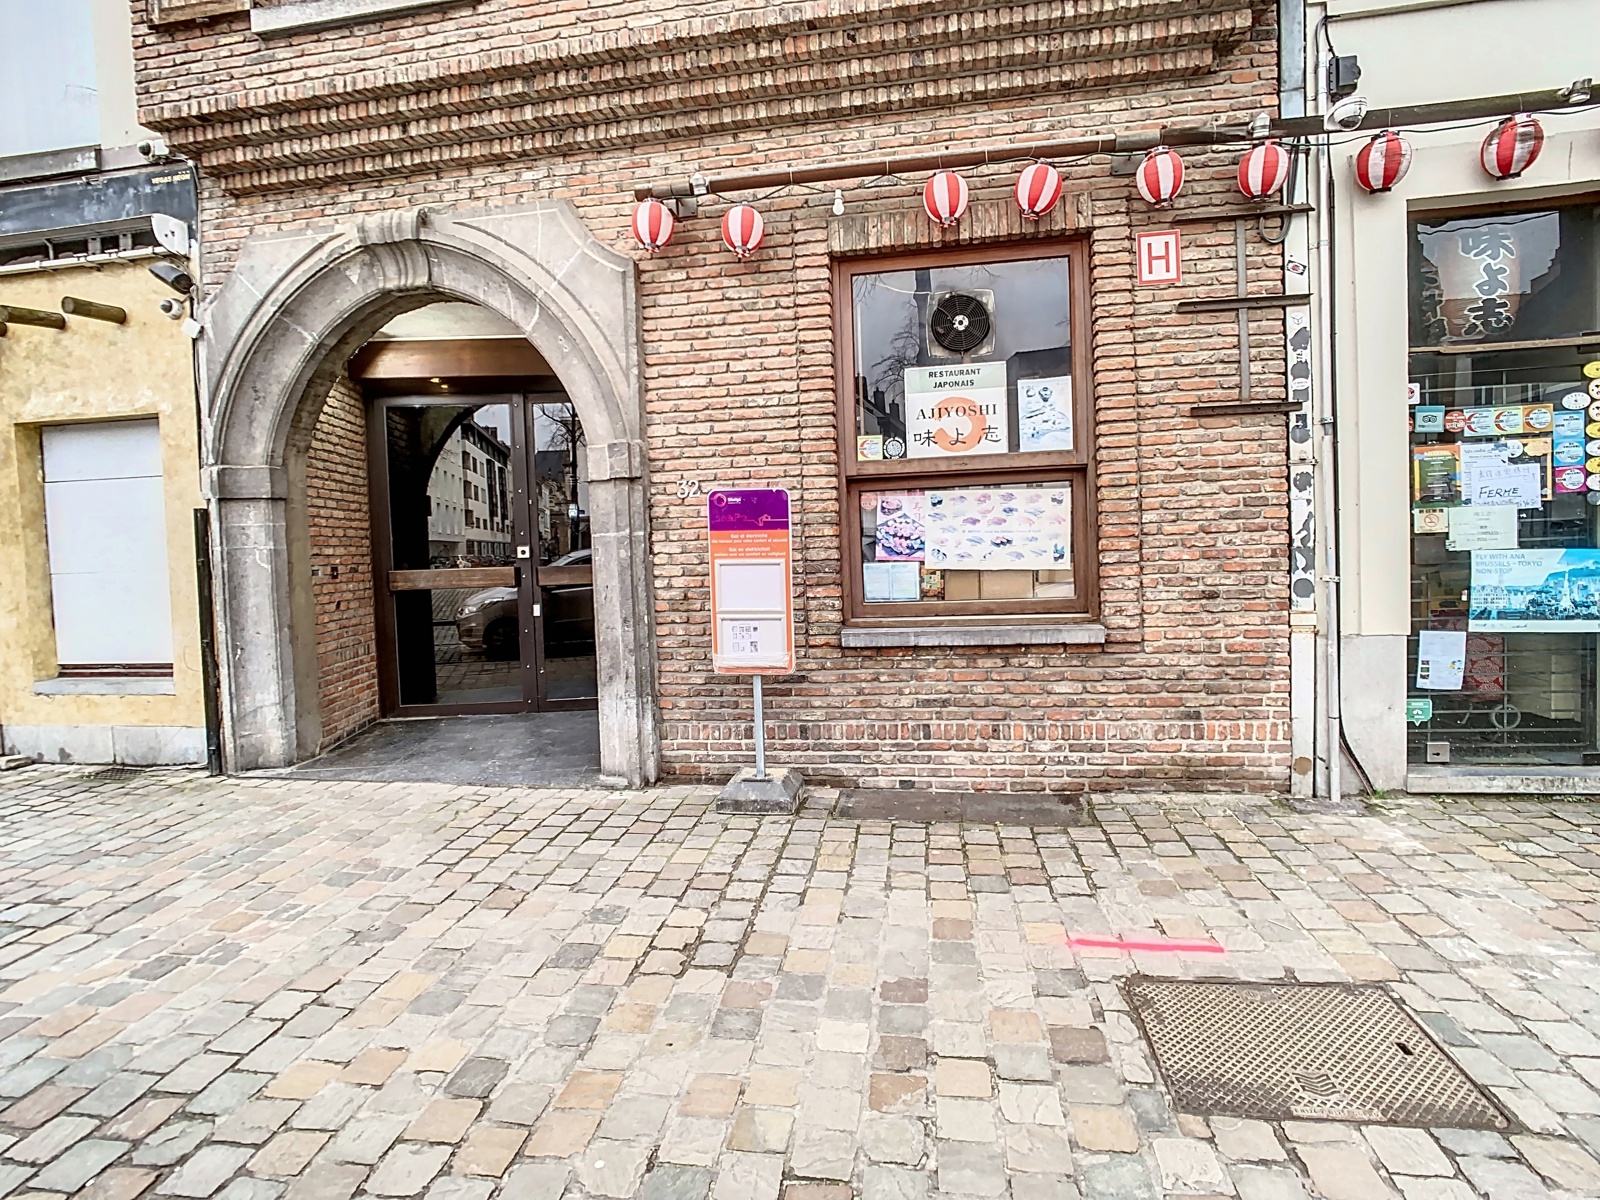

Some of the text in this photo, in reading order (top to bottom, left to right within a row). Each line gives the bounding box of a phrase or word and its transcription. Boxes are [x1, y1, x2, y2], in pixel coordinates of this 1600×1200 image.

[151, 174, 190, 184] VEGAS NEON
[1147, 241, 1171, 275] H
[928, 367, 982, 379] RESTAURANT
[932, 379, 975, 389] JAPONAIS
[916, 403, 998, 420] AJIYOSHI
[676, 480, 700, 498] 32
